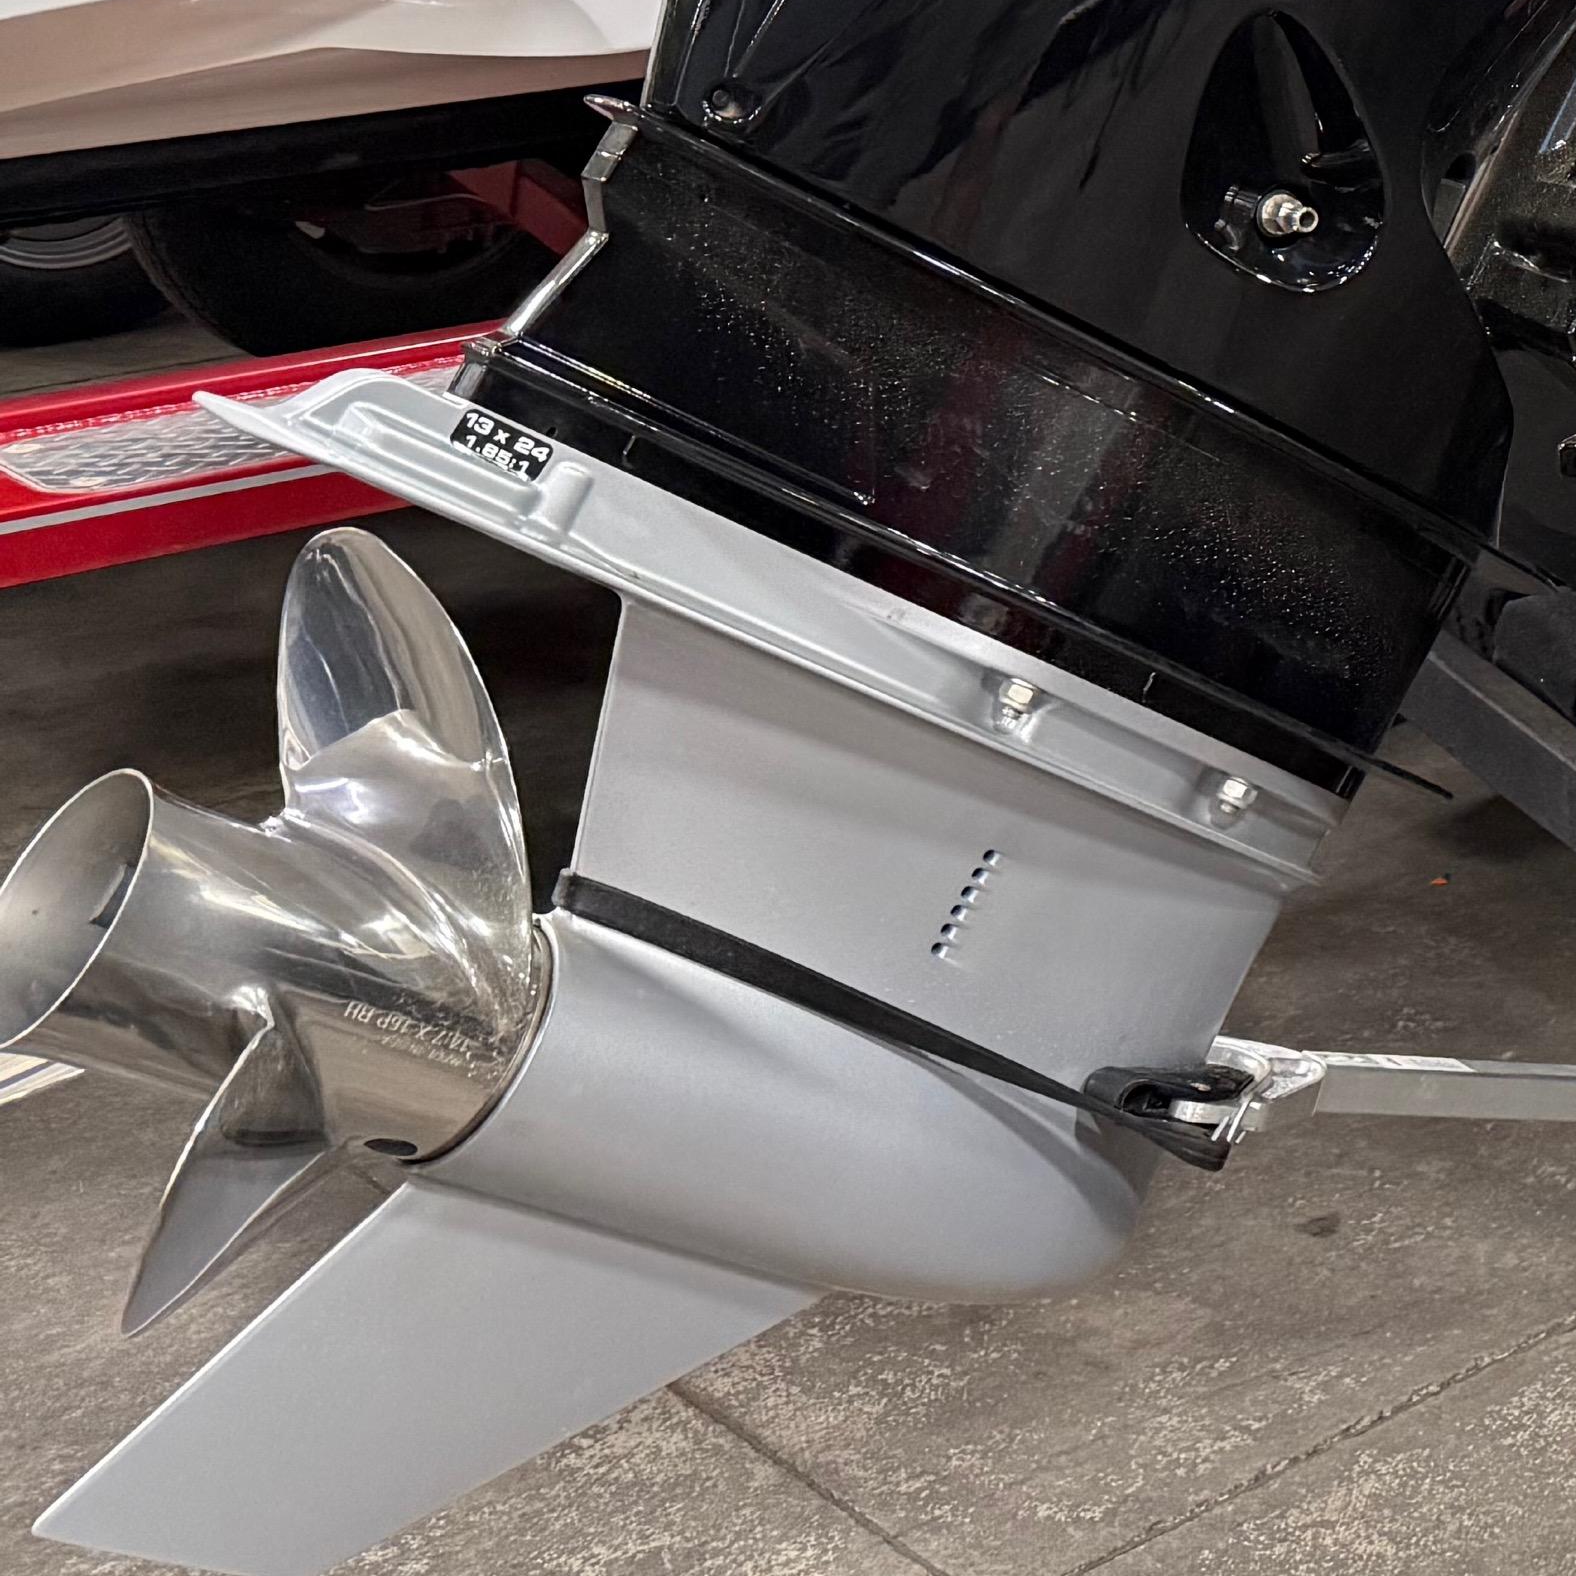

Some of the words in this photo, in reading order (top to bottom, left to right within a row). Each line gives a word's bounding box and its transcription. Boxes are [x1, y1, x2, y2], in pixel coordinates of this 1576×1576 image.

[465, 435, 530, 475] 1.85:1
[466, 412, 495, 436] 13
[493, 429, 511, 444] x
[513, 436, 550, 462] 24
